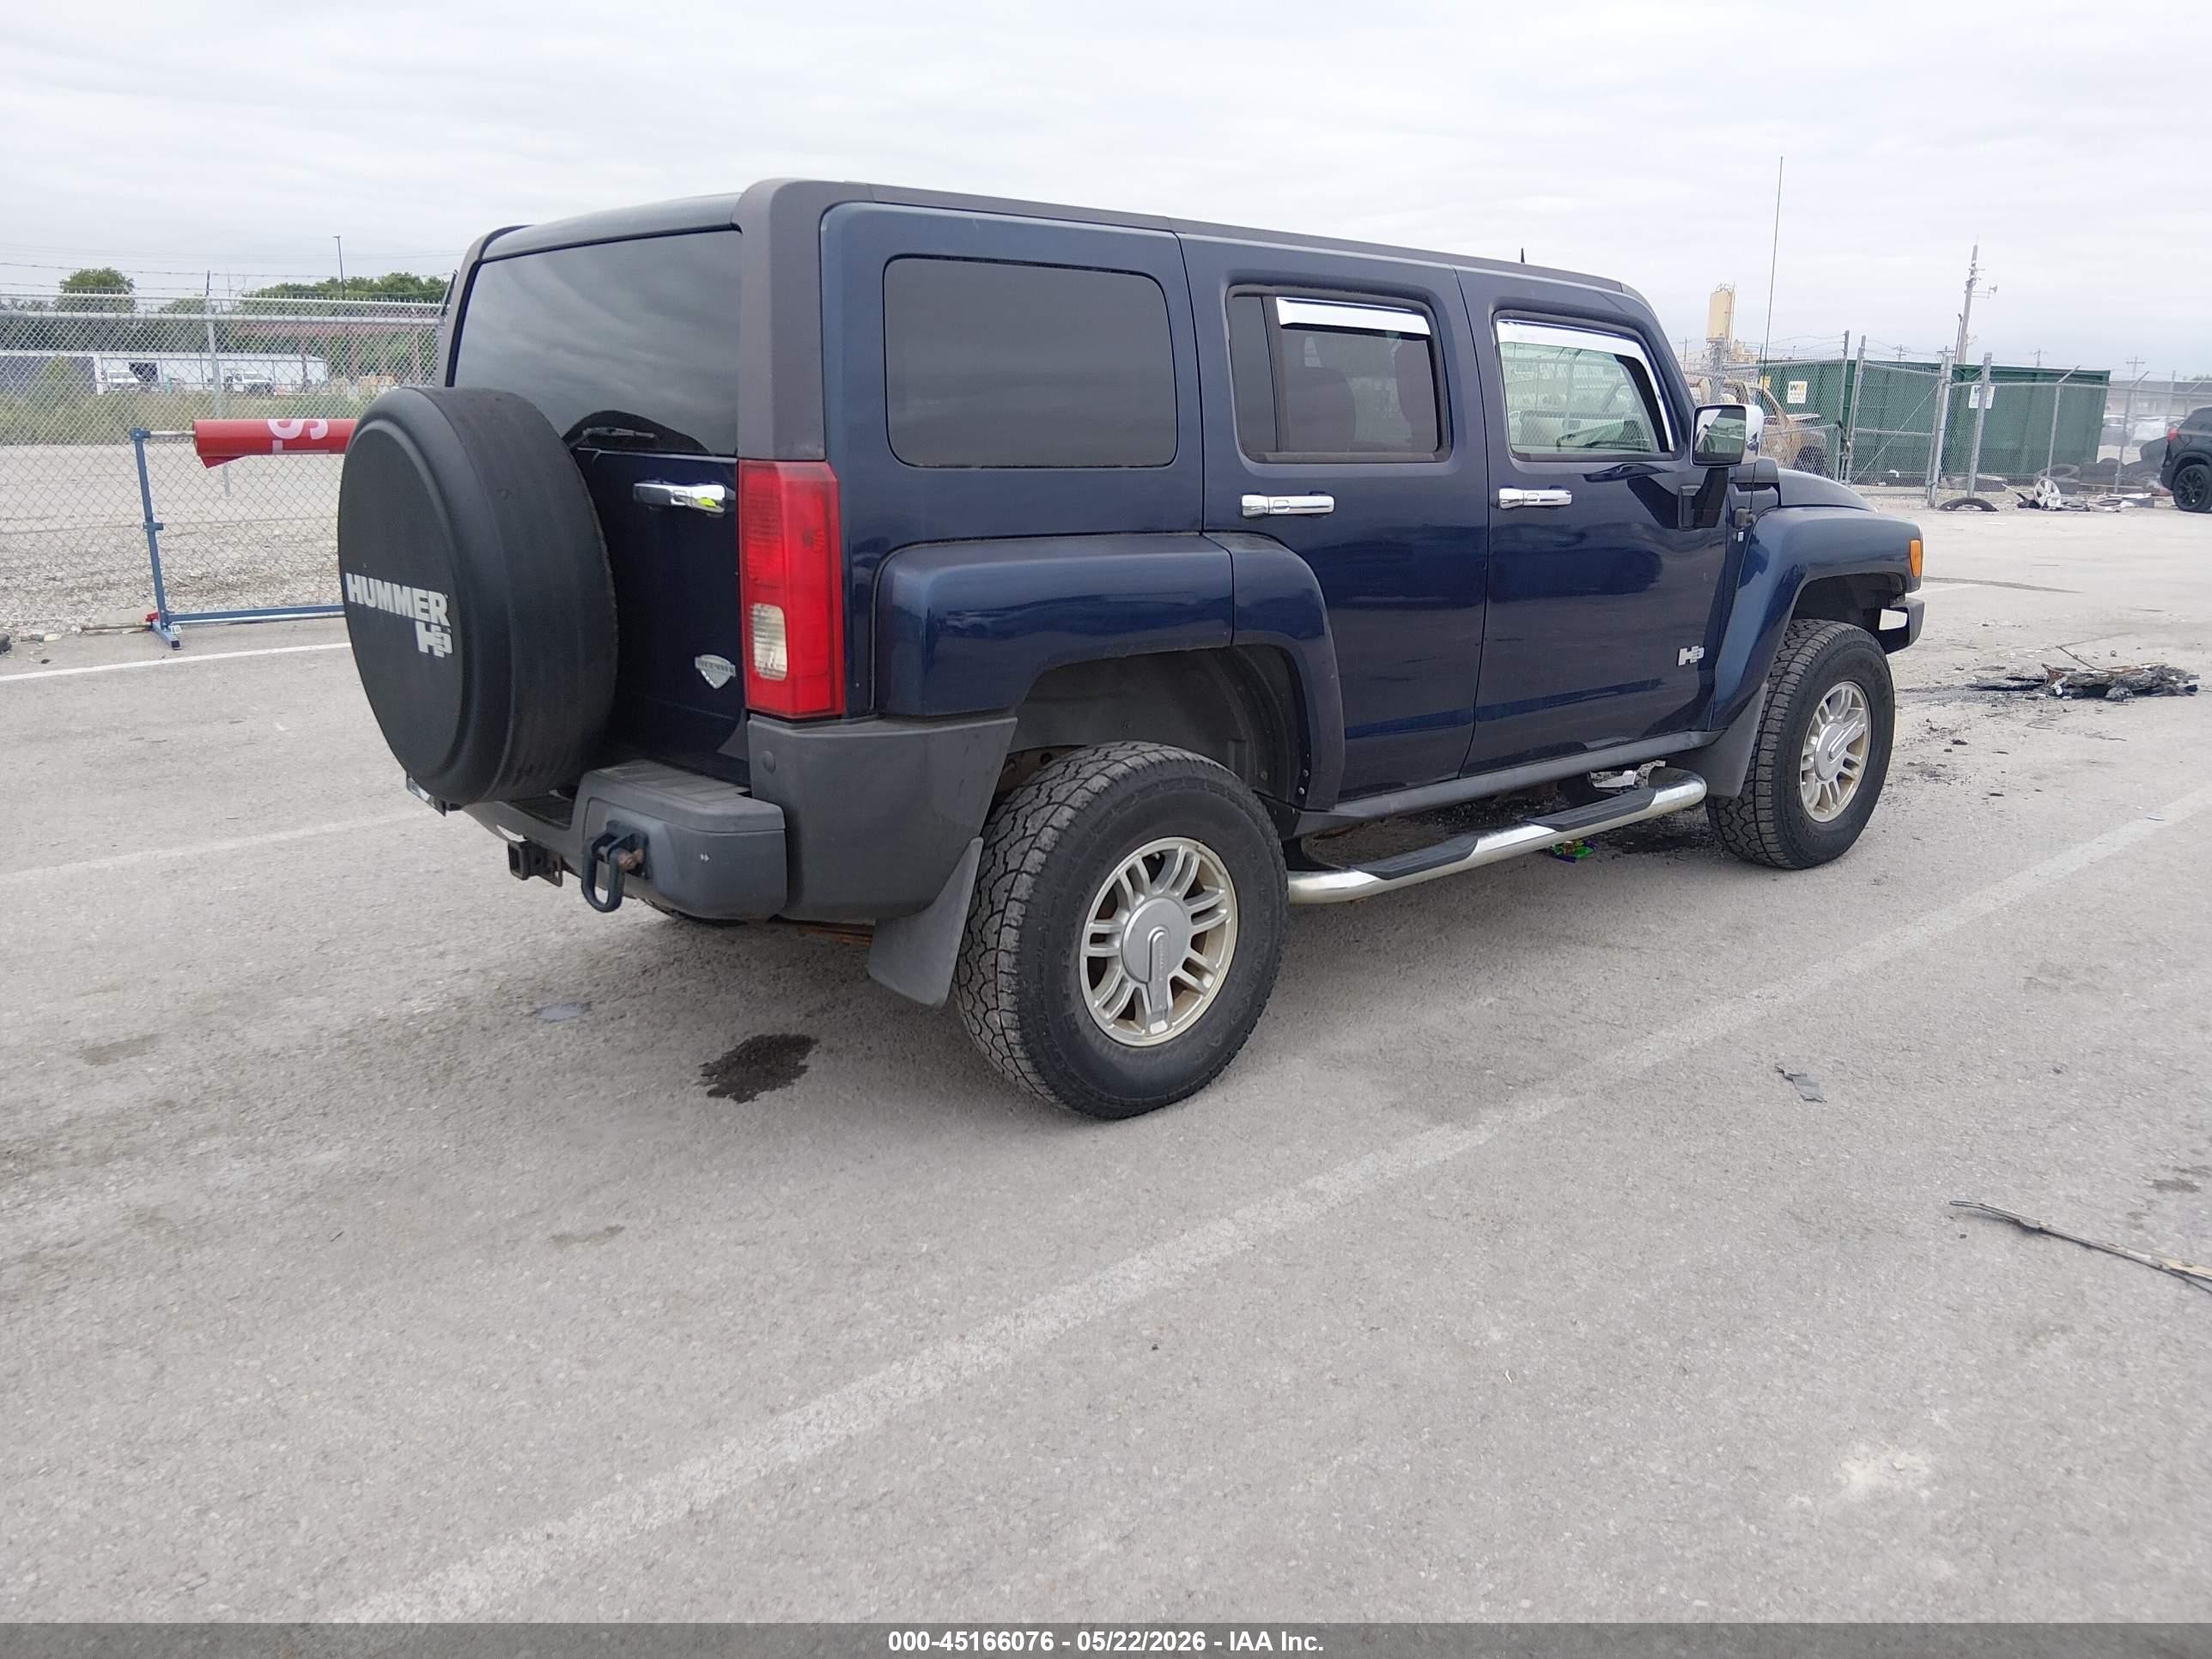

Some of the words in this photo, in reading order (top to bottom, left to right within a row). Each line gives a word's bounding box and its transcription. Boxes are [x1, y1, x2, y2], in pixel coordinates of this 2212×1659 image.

[345, 573, 451, 627] HUMMER
[415, 620, 453, 658] H3
[1678, 645, 1705, 665] H3
